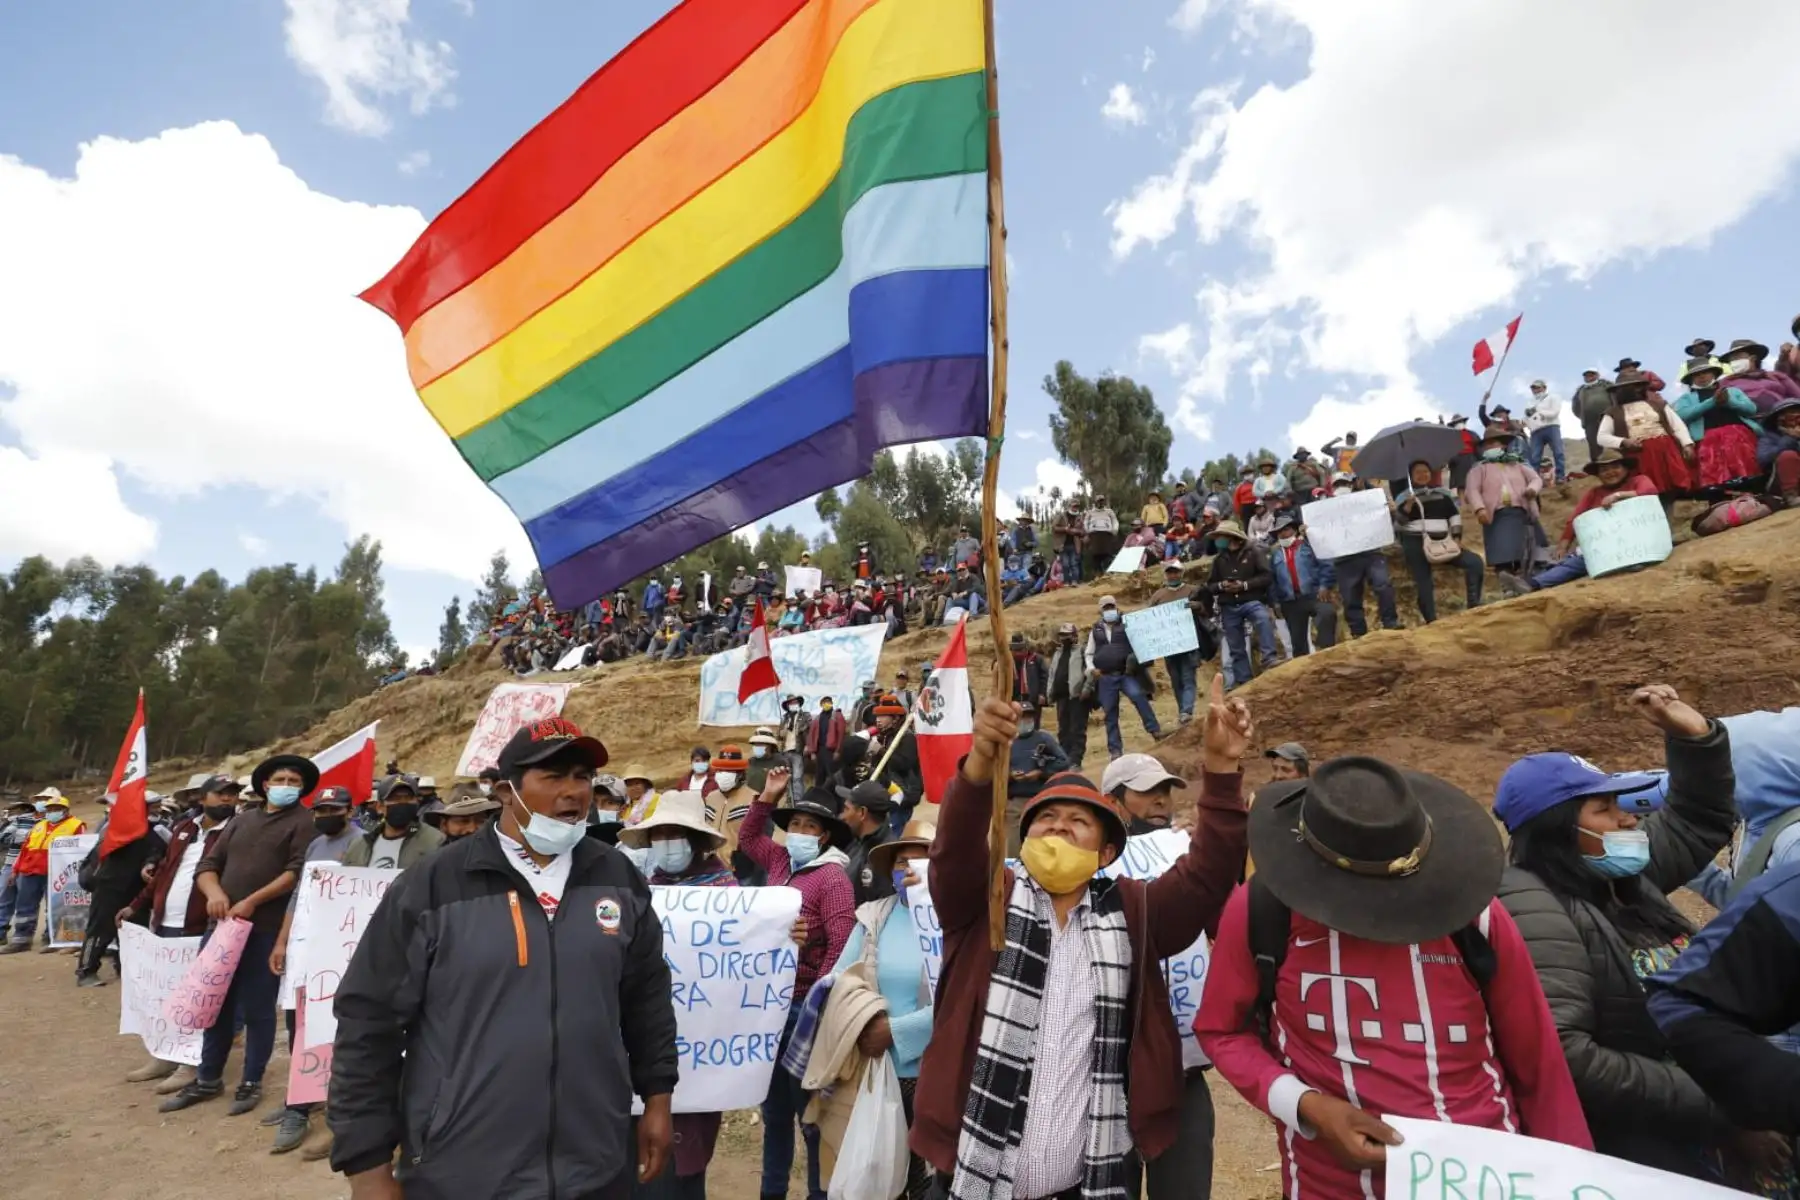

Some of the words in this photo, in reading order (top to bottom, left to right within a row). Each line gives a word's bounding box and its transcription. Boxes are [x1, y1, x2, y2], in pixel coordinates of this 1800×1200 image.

[319, 871, 392, 901] REINC
[691, 918, 740, 946] DE
[699, 947, 796, 980] DIRECTA
[740, 984, 794, 1011] LAS
